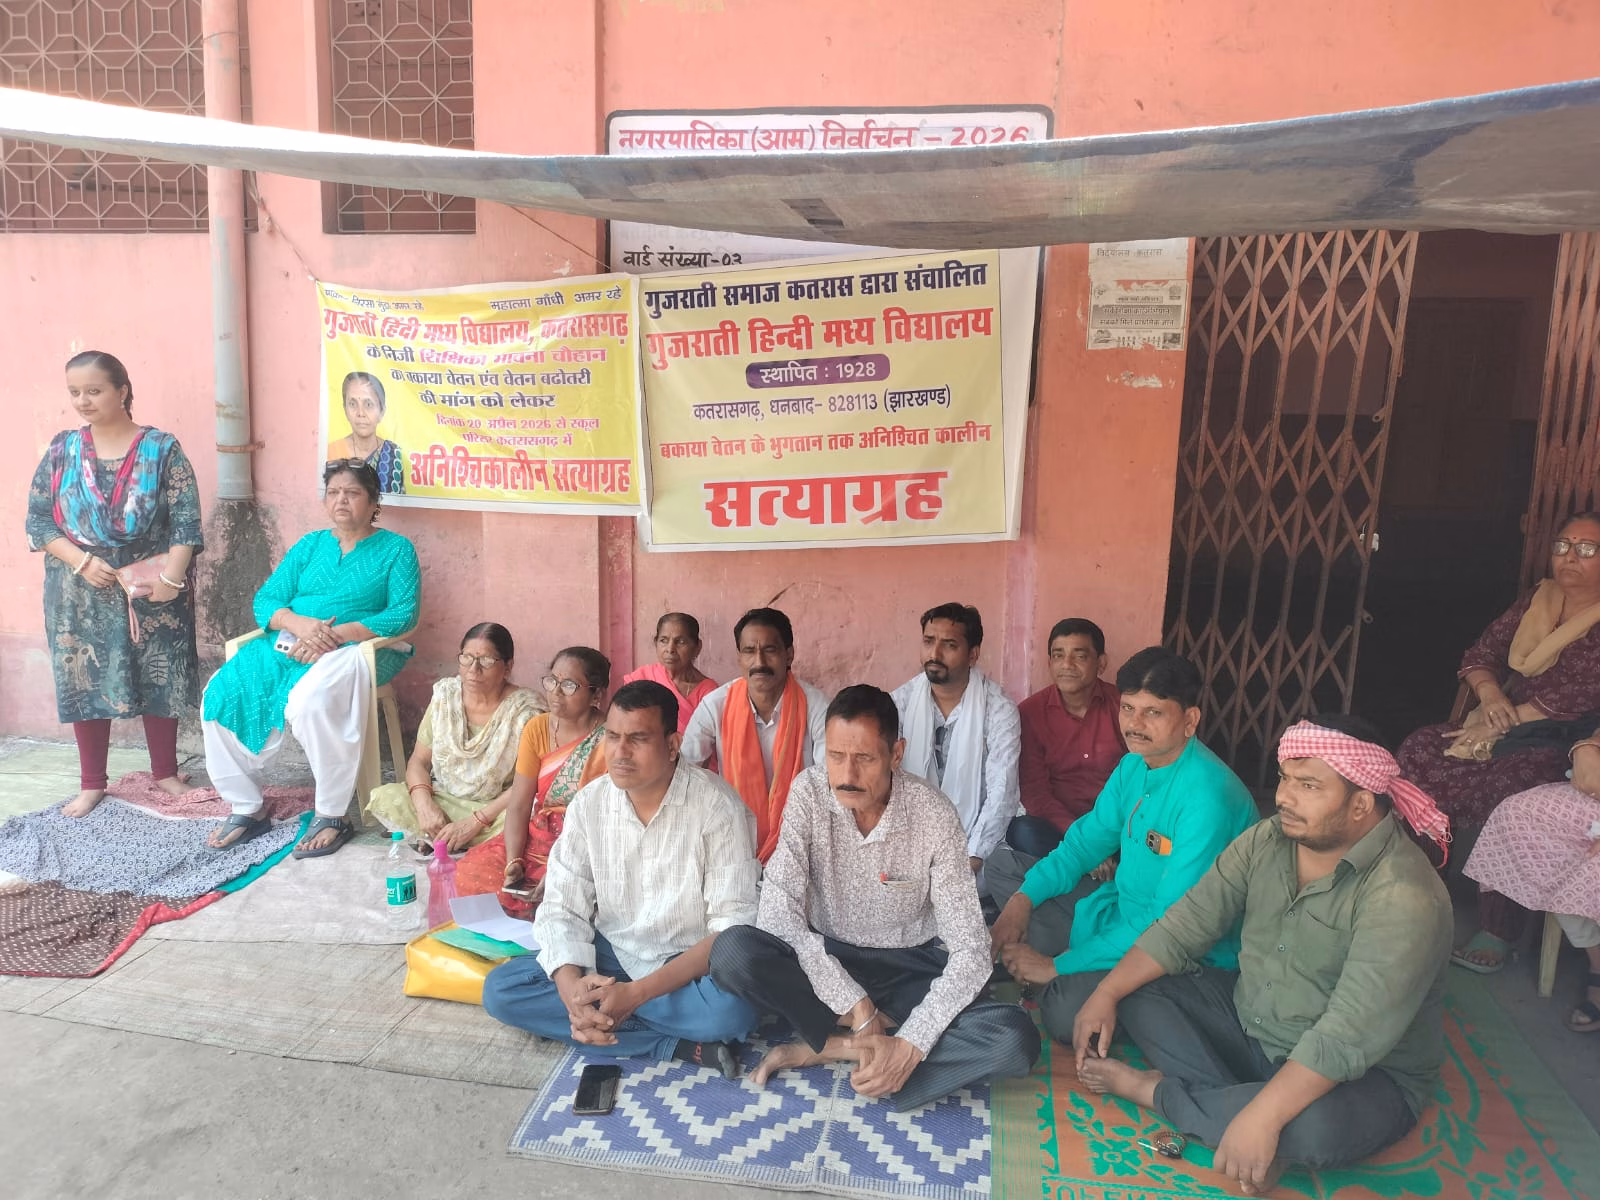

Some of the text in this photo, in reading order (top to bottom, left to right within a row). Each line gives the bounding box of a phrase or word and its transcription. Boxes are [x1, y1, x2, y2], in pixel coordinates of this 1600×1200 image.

[618, 120, 748, 150] नगरपालिका
[751, 124, 816, 152] (आम)
[819, 119, 920, 149] निर्वाचन
[950, 126, 1030, 146] 2026
[623, 244, 654, 267] वार्ड
[490, 298, 531, 311] महात्मा
[574, 291, 602, 303] अमर
[605, 285, 622, 300] रहे
[645, 259, 988, 319] गुजराती समाज कतरास द्वारा संचालित
[380, 316, 421, 341] हिंदी
[423, 322, 458, 344] मध्य
[646, 306, 993, 371] गुजराती हिन्दी मध्य विद्यालय
[381, 344, 415, 362] निजी
[550, 346, 606, 362] चौहान
[445, 369, 476, 386] वेतन
[503, 369, 536, 386] वेतन
[760, 360, 818, 384] स्थापित
[835, 362, 876, 379] 1928
[419, 389, 556, 407] की मांग को लेकर
[692, 400, 765, 422] कतरासगढ़,
[828, 393, 878, 413] 828113
[884, 384, 952, 413] (झारखण्ड)
[467, 419, 481, 429] 20
[520, 419, 551, 429] 2026
[556, 416, 567, 429] से
[570, 418, 600, 431] स्कूल
[562, 432, 573, 446] में
[659, 420, 992, 460] बकाया वेतन के भुगतान तक अनिश्चित कालीन
[551, 458, 631, 494] सत्याग्रह
[704, 470, 948, 528] सत्याग्रह
